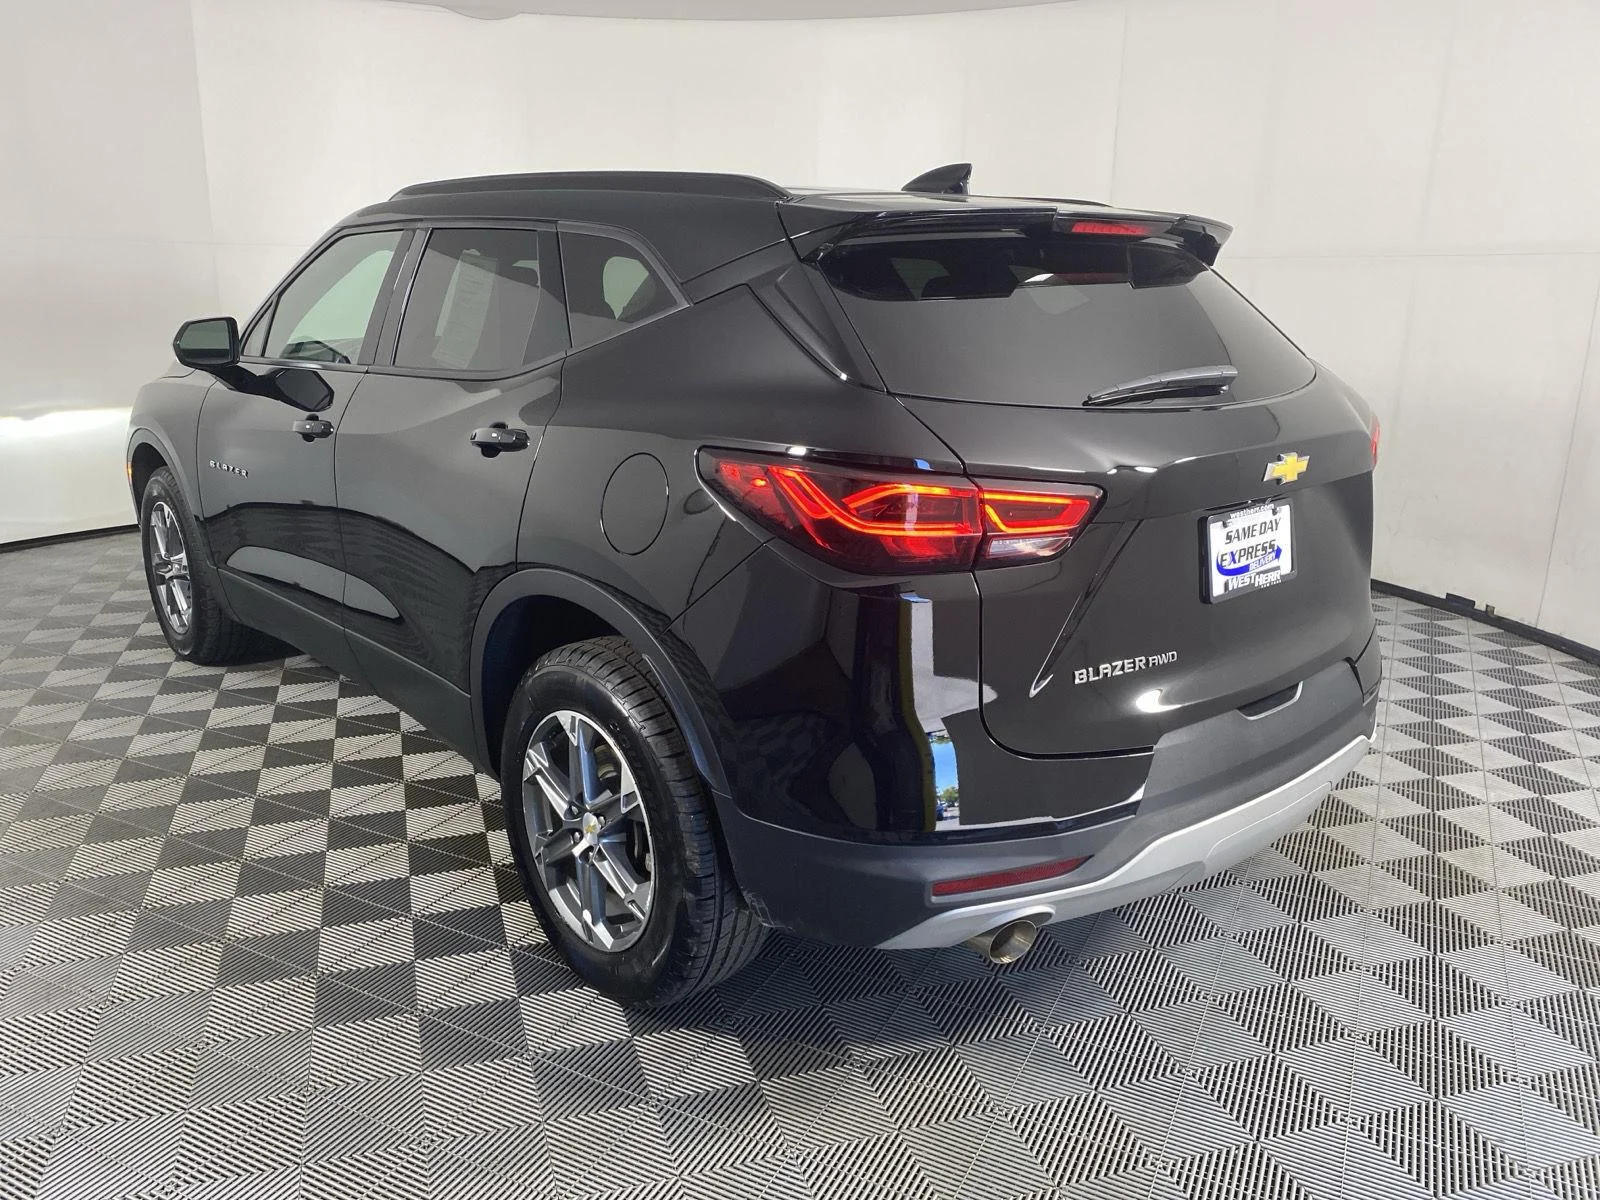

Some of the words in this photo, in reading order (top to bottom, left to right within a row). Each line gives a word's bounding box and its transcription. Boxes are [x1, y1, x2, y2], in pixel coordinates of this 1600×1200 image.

[209, 460, 248, 479] BLAZER
[1225, 523, 1258, 545] SAME
[1259, 517, 1282, 536] DAY
[1219, 540, 1277, 568] EXPRESS
[1074, 656, 1146, 685] BLAZER
[1148, 651, 1178, 668] AWD
